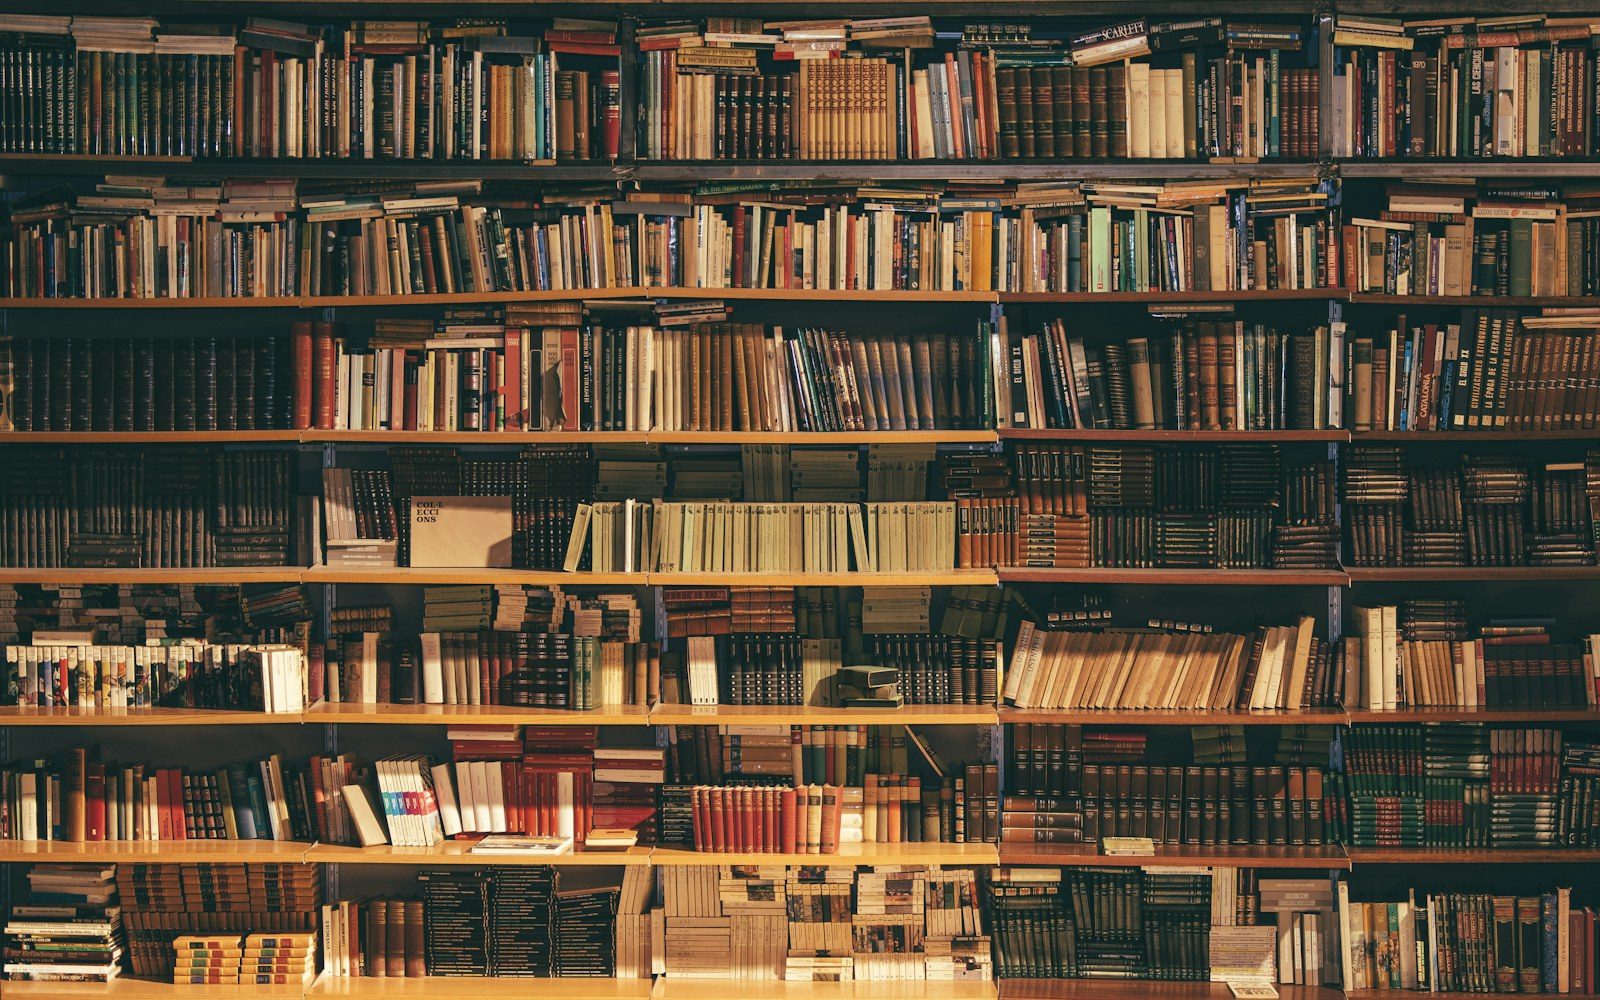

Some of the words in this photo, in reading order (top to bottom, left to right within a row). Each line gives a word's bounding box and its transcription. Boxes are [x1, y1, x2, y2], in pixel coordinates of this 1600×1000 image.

[1101, 21, 1145, 40] SCARLETT
[1472, 50, 1481, 79] CIENCIAS
[1472, 81, 1481, 94] LAS
[1013, 347, 1020, 356] XX
[1461, 350, 1469, 358] XX
[1476, 316, 1487, 357] EXTINGUIDAS
[1504, 318, 1514, 356] OCCIDENTAL
[1460, 362, 1468, 377] SIGLO
[1485, 379, 1495, 398] ÉPOCA
[1490, 319, 1501, 354] EXPANSIÓN
[1444, 362, 1453, 391] LATINA
[1471, 360, 1483, 408] CIVILIZACIONES
[1499, 359, 1510, 398] CIVILIZACIÓN
[1420, 374, 1430, 417] CATALONIA
[1016, 627, 1031, 662] PARNASO
[1027, 636, 1042, 672] PARNASO
